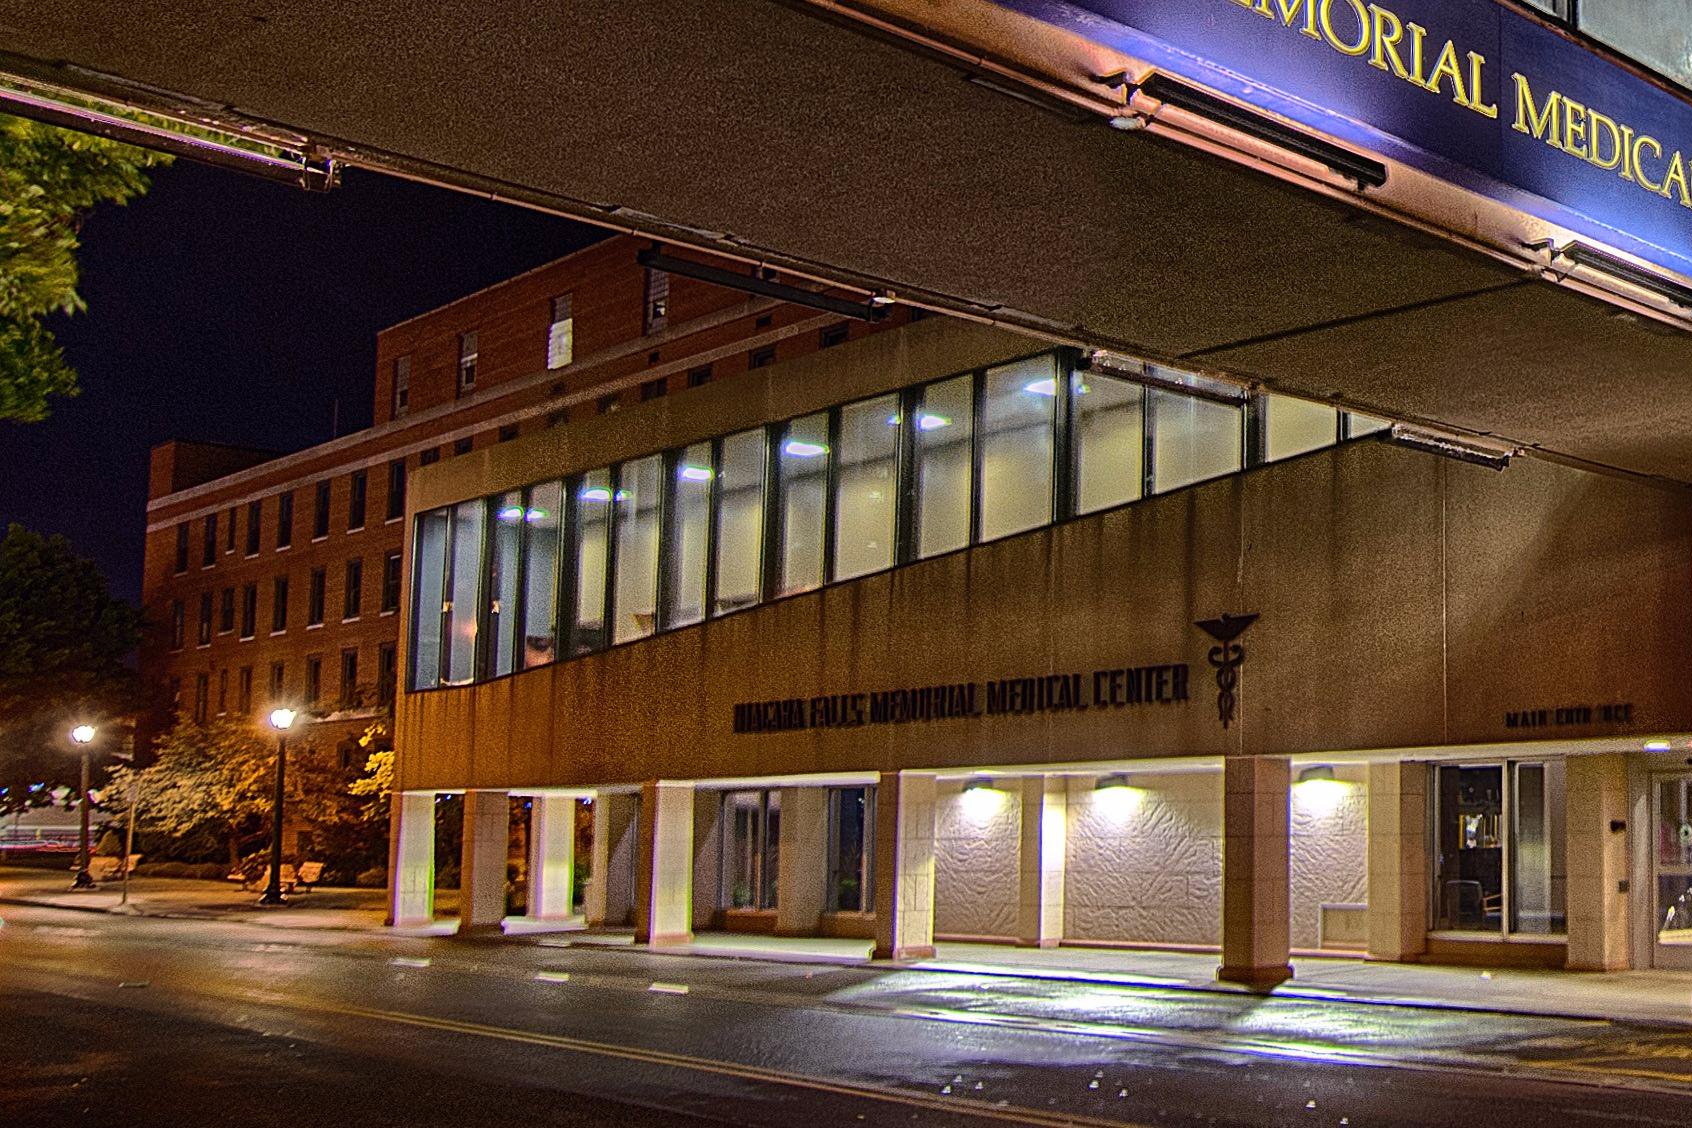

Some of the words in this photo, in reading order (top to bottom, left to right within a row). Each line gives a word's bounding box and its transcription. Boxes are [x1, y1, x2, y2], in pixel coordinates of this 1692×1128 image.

[1230, 0, 1498, 118] MORIAL
[809, 692, 866, 729] FALLS
[870, 682, 981, 724] MEMORIAL
[986, 673, 1089, 714] MEDICAL
[1092, 663, 1190, 707] CENTER
[1506, 709, 1548, 728] MAIN
